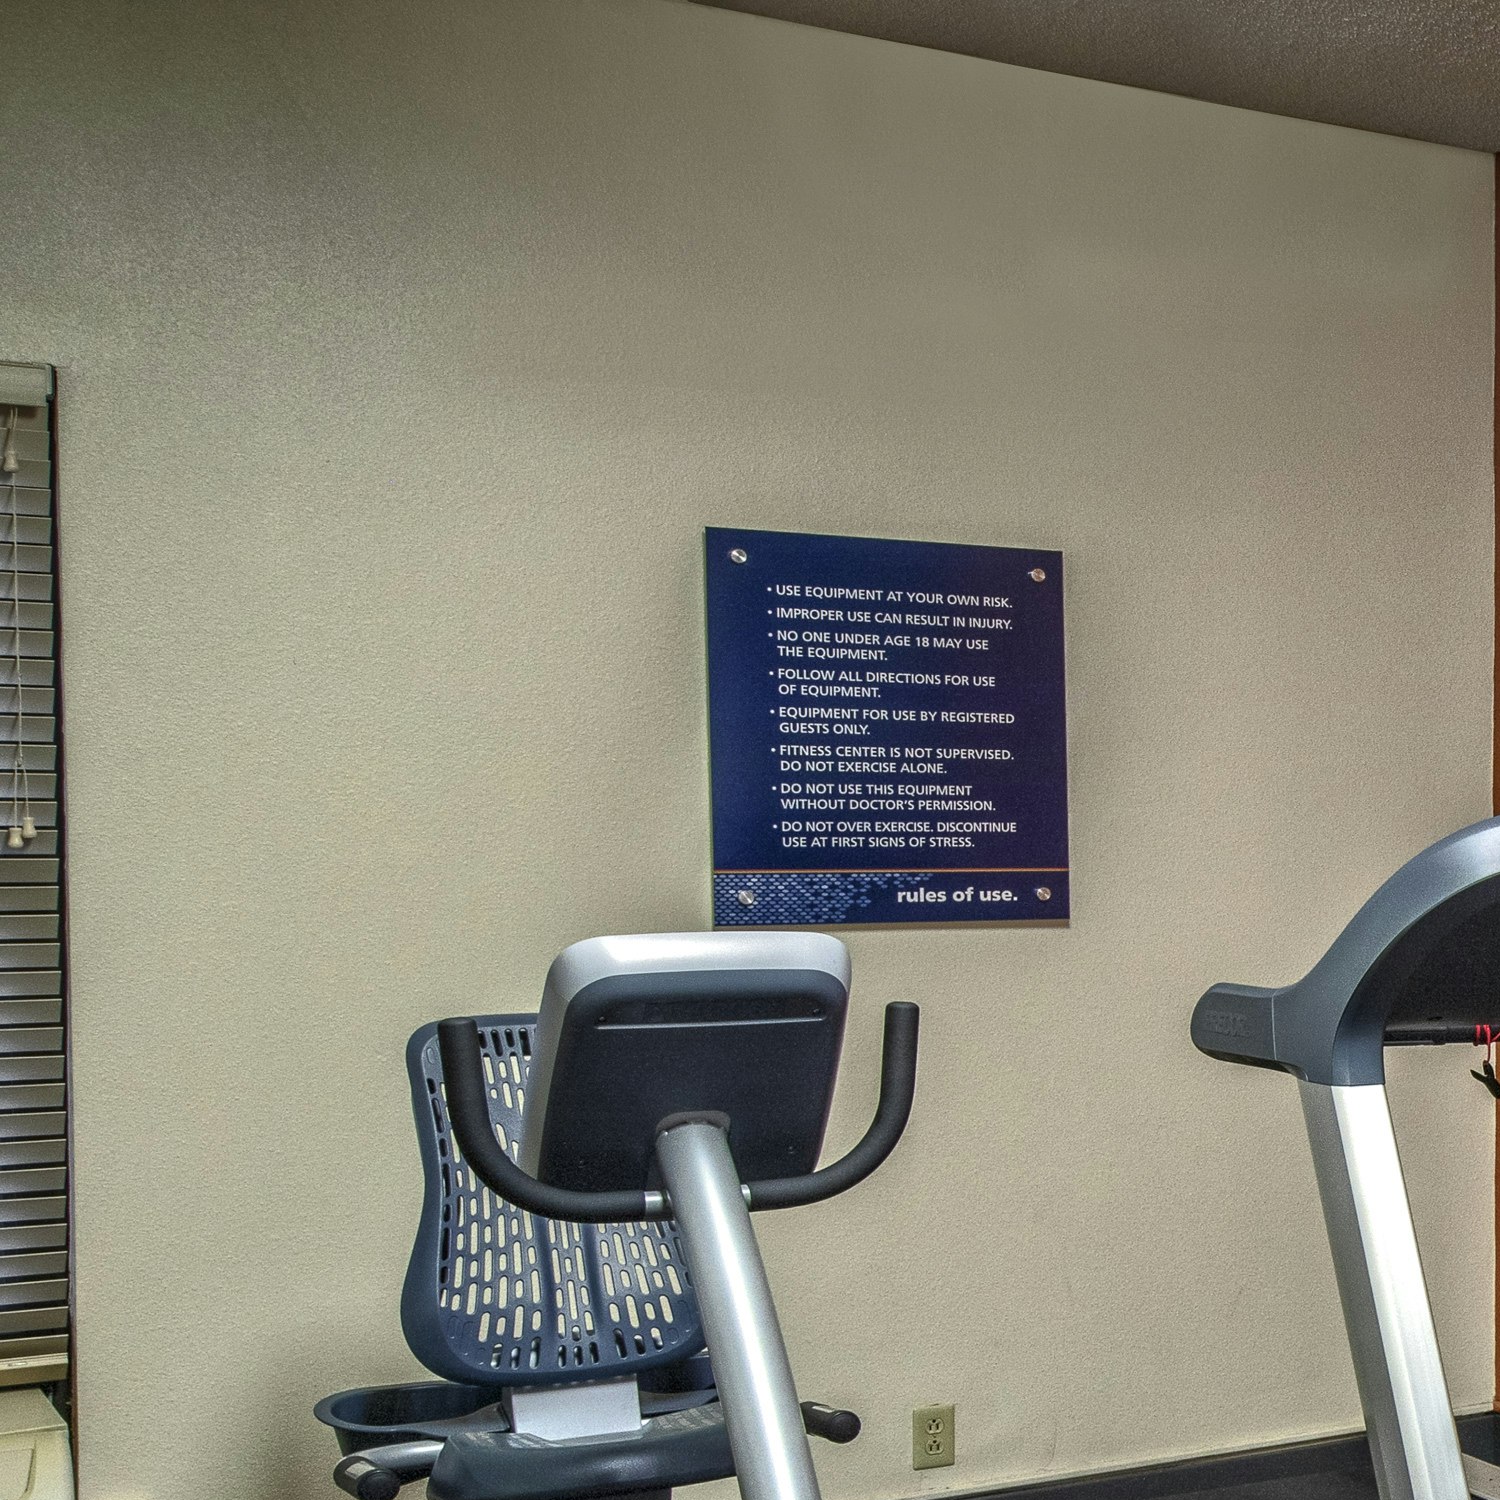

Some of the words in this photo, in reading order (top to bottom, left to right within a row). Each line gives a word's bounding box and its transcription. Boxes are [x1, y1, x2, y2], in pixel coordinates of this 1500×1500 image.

[776, 584, 801, 596] USE
[805, 586, 883, 601] EQUIPMENT
[886, 591, 903, 602] AT
[906, 592, 944, 604] YOUR
[947, 594, 979, 606] OWN
[983, 596, 1013, 608] RISK.
[776, 607, 844, 621] IMPROPER
[847, 611, 871, 622] USE
[874, 612, 902, 624] CAN
[905, 614, 950, 626] RESULT
[953, 616, 965, 627] IN
[969, 617, 1013, 630] INJURY.
[777, 630, 798, 641] NO
[802, 631, 831, 643] ONE
[835, 633, 880, 645] UNDER
[884, 635, 911, 647] AGE
[915, 637, 930, 647] 18
[933, 637, 963, 649] MAY
[966, 639, 989, 650] USE
[777, 645, 803, 657] THE
[808, 647, 888, 661] EQUIPMENT.
[778, 668, 835, 681] FOLLOW
[838, 671, 863, 682] ALL
[866, 671, 941, 685] DIRECTIONS
[945, 675, 969, 686] FOR
[973, 676, 995, 687] USE
[778, 684, 797, 695] OF
[801, 685, 881, 698] EQUIPMENT.
[779, 706, 859, 719] EQUIPMENT
[862, 709, 889, 720] FOR
[892, 710, 916, 721] USE
[920, 711, 937, 721] BY
[941, 711, 1015, 724] REGISTERED
[779, 722, 830, 734] GUESTS
[833, 723, 870, 735] ONLY.
[780, 745, 832, 756] FITNESS
[835, 746, 886, 757] CENTER
[890, 747, 901, 758] IS
[905, 747, 933, 758] NOT
[936, 748, 1014, 760] SUPERVISED.
[780, 760, 802, 772] DO
[805, 761, 835, 772] NOT
[838, 761, 896, 773] EXERCISE
[900, 763, 947, 774] ALONE.
[781, 783, 802, 794] DO
[806, 783, 835, 794] NOT
[838, 784, 862, 795] USE
[865, 784, 894, 795] THIS
[898, 784, 973, 797] EQUIPMENT
[780, 798, 846, 810] WITHOUT
[849, 799, 915, 810] DOCTOR'S
[918, 800, 996, 811] PERMISSION.
[782, 821, 802, 832] DO
[806, 821, 834, 832] NOT
[836, 821, 872, 832] OVER
[875, 821, 934, 832] EXERCISE.
[937, 822, 1017, 833] DISCONTINUE
[782, 837, 807, 847] USE
[811, 837, 828, 847] AT
[832, 837, 865, 847] FIRST
[868, 837, 906, 847] SIGNS
[909, 837, 926, 847] OF
[929, 837, 975, 847] STRESS.
[897, 888, 947, 903] rules
[953, 887, 976, 902] of
[979, 889, 1018, 902] use.
